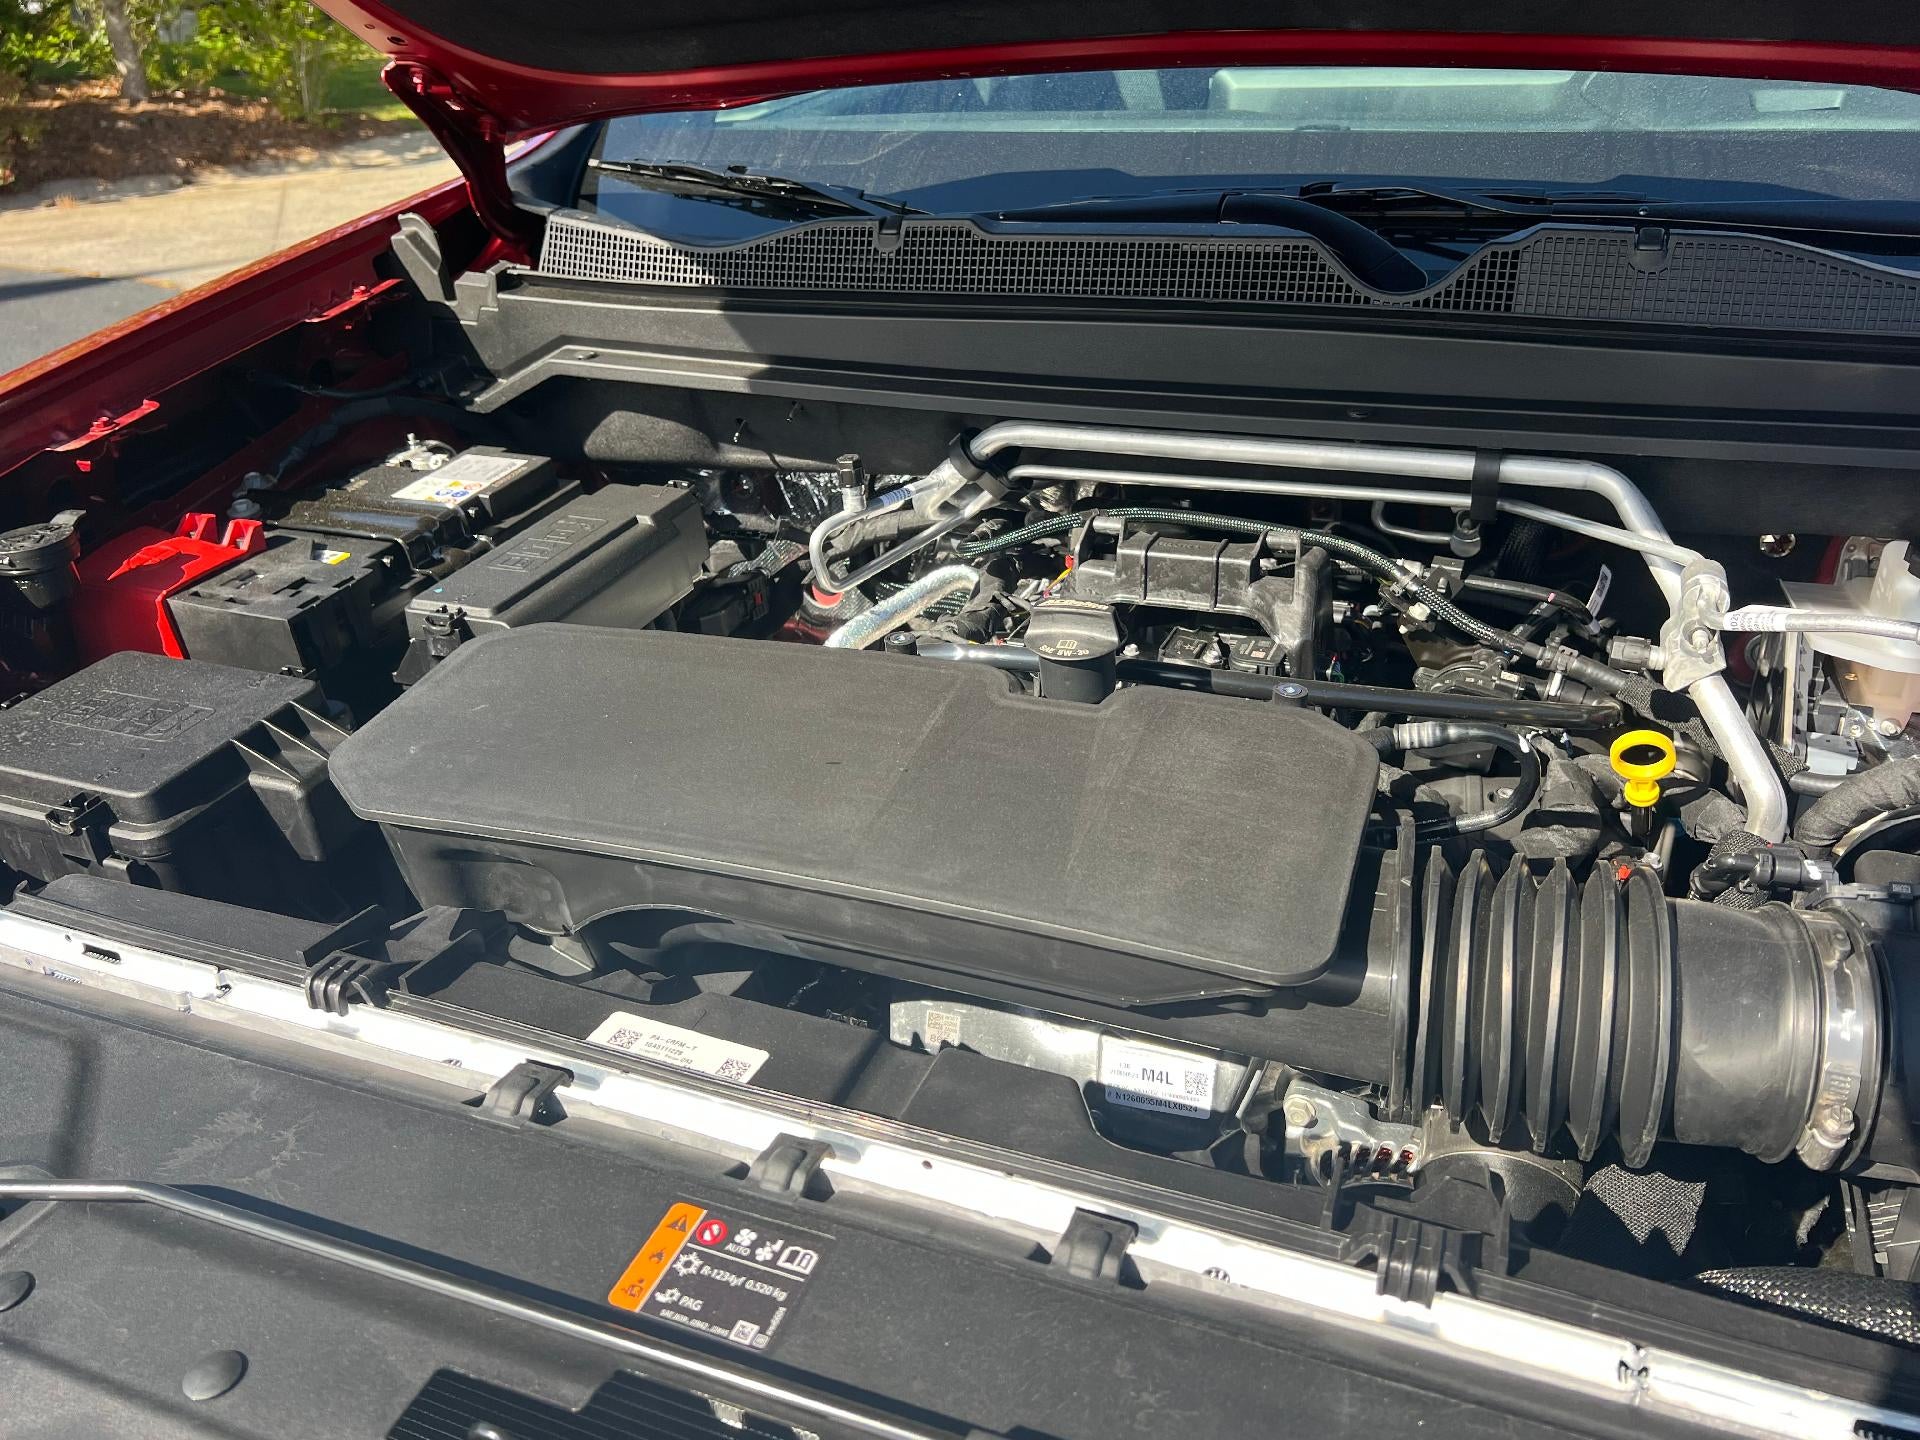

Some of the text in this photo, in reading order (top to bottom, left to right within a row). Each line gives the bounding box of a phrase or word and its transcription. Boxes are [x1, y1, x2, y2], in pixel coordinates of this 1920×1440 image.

[1141, 1067, 1174, 1086] M4L
[725, 1242, 751, 1256] AUTO
[745, 1279, 773, 1296] 0.520
[772, 1288, 788, 1301] kg
[679, 1296, 703, 1311] PAG
